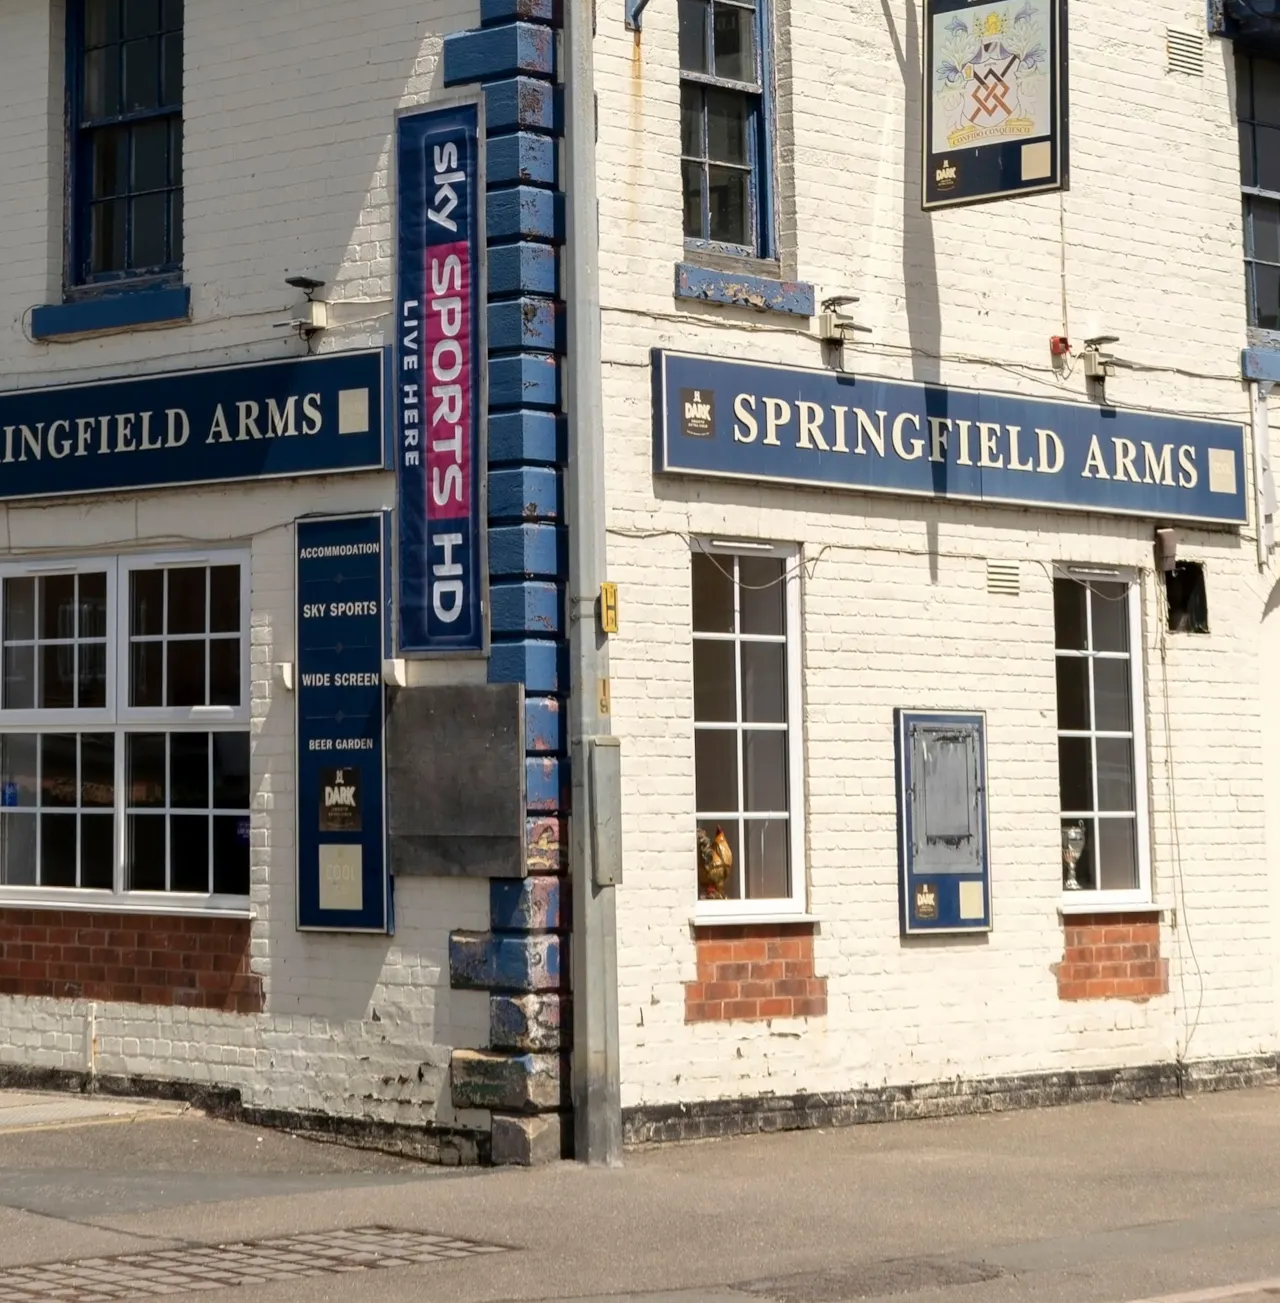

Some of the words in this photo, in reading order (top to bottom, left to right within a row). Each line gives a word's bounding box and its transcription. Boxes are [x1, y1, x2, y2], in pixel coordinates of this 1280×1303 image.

[427, 141, 466, 233] sky
[403, 299, 419, 371] LIVE
[431, 254, 463, 506] SPORTS
[205, 392, 323, 444] ARMS
[403, 384, 420, 466] HERE
[685, 402, 711, 421] DARK
[733, 393, 1065, 474] SPRINGFIELD
[1081, 434, 1198, 489] ARMS
[300, 542, 380, 559] ACCOMMODATION
[432, 532, 463, 623] HD
[303, 603, 326, 619] SKY
[330, 601, 377, 617] SPORTS
[302, 673, 331, 687] WIDE
[334, 673, 379, 686] SCREEN
[308, 739, 333, 751] BEER
[335, 738, 374, 750] GARDEN
[325, 786, 356, 807] DARK
